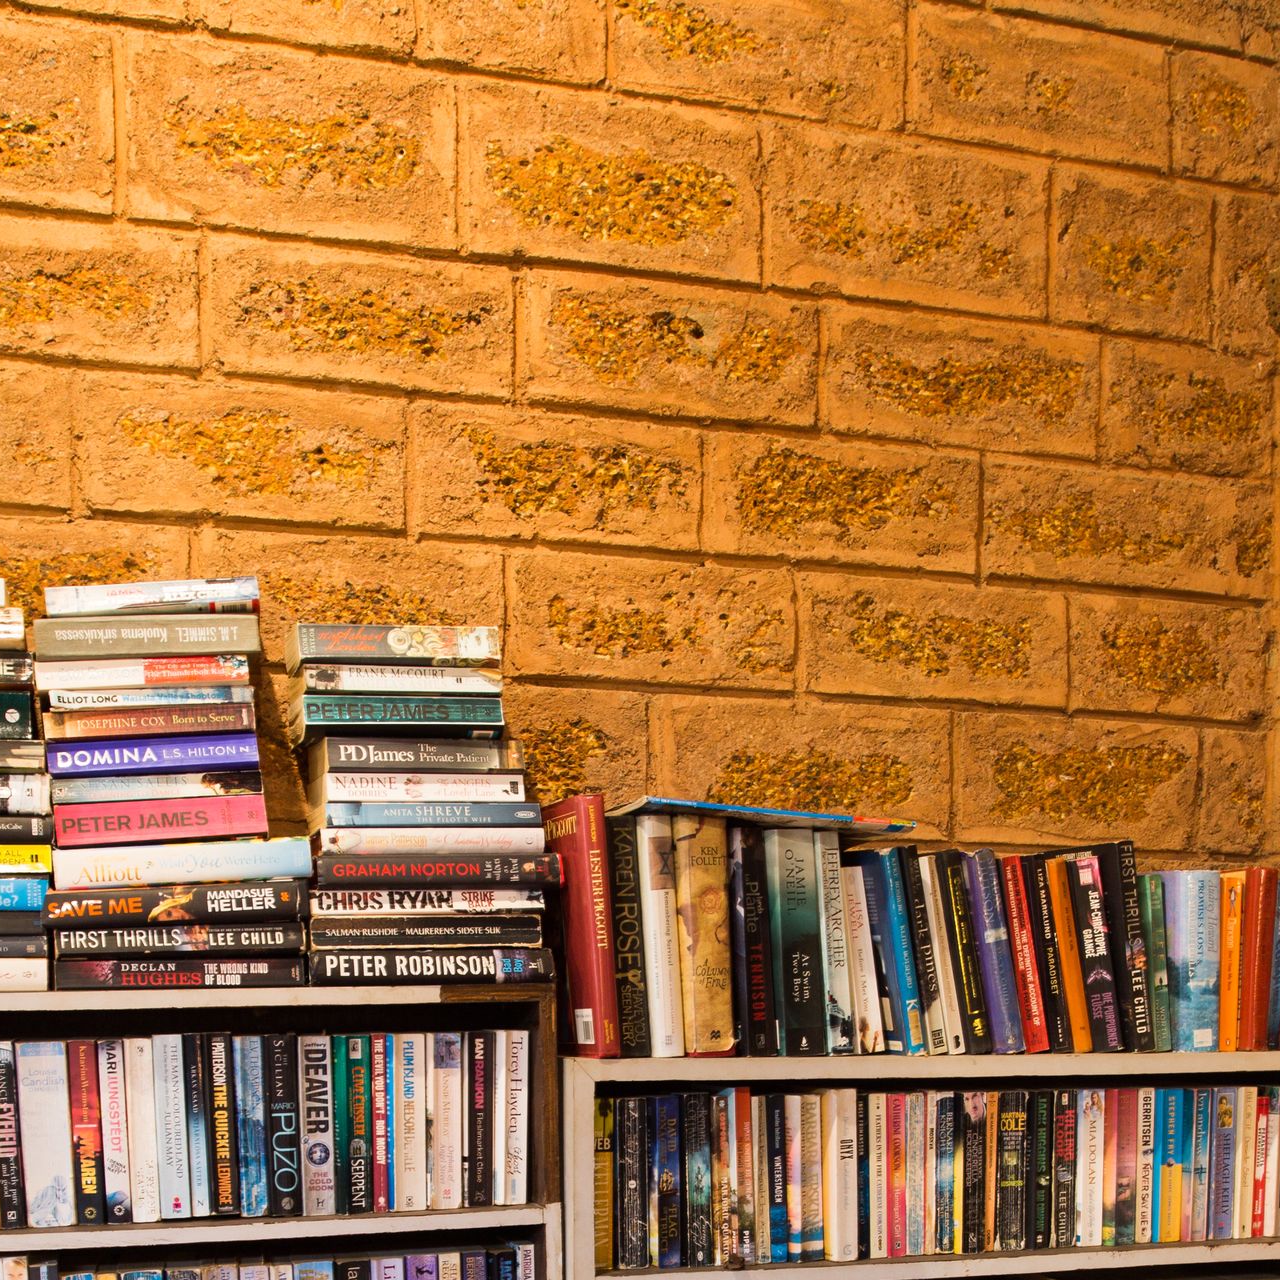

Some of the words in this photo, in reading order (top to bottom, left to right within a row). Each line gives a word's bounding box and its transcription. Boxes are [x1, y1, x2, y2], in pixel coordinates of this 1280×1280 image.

[54, 629, 117, 645] sirkuksessa
[122, 628, 167, 643] Kuolema
[58, 696, 89, 704] ELLIOT
[92, 695, 118, 703] LONG
[77, 717, 137, 730] JOSEPHINE
[141, 717, 165, 727] COX
[57, 748, 157, 767] DOMINA
[163, 748, 184, 759] L.S.
[188, 746, 235, 757] HILTON
[418, 744, 436, 752] The
[419, 753, 454, 763] Private
[456, 753, 490, 762] Patient
[62, 816, 130, 834] PETER
[139, 811, 209, 828] JAMES
[384, 809, 413, 817] ANITA
[415, 807, 471, 816] SHREVE
[701, 847, 718, 855] KEN
[333, 864, 406, 876] GRAHAM
[411, 863, 480, 876] NORTON
[590, 850, 601, 894] LESTER
[613, 828, 637, 898] KAREN
[207, 889, 274, 899] MANDASUE
[318, 891, 383, 911] CHRIS
[387, 891, 453, 909] RYAN
[461, 891, 495, 900] STRIKE
[48, 900, 102, 919] SAVE
[108, 897, 143, 913] ME
[208, 898, 276, 912] HELLER
[593, 895, 609, 949] PIGGOTT
[60, 931, 107, 948] FIRST
[113, 929, 182, 947] THRILLS
[209, 933, 235, 946] LEE
[241, 932, 284, 945] CHILD
[616, 903, 640, 969] ROSE
[121, 964, 176, 972] DECLAN
[326, 955, 386, 976] PETER
[396, 955, 495, 975] ROBINSON
[121, 973, 202, 985] HUGHES
[751, 944, 766, 1021] TENNISON
[1132, 970, 1142, 991] LEE
[1135, 994, 1146, 1034] CHILD
[474, 1038, 484, 1059] IAN
[304, 1049, 330, 1134] DEAVER
[475, 1062, 484, 1109] RANKIN
[1142, 1095, 1152, 1147] GERRITSEN
[272, 1112, 298, 1192] PUZO
[840, 1139, 853, 1161] ONYX
[351, 1159, 365, 1208] SERPENT
[774, 1155, 783, 1204] VINTERSTADEN
